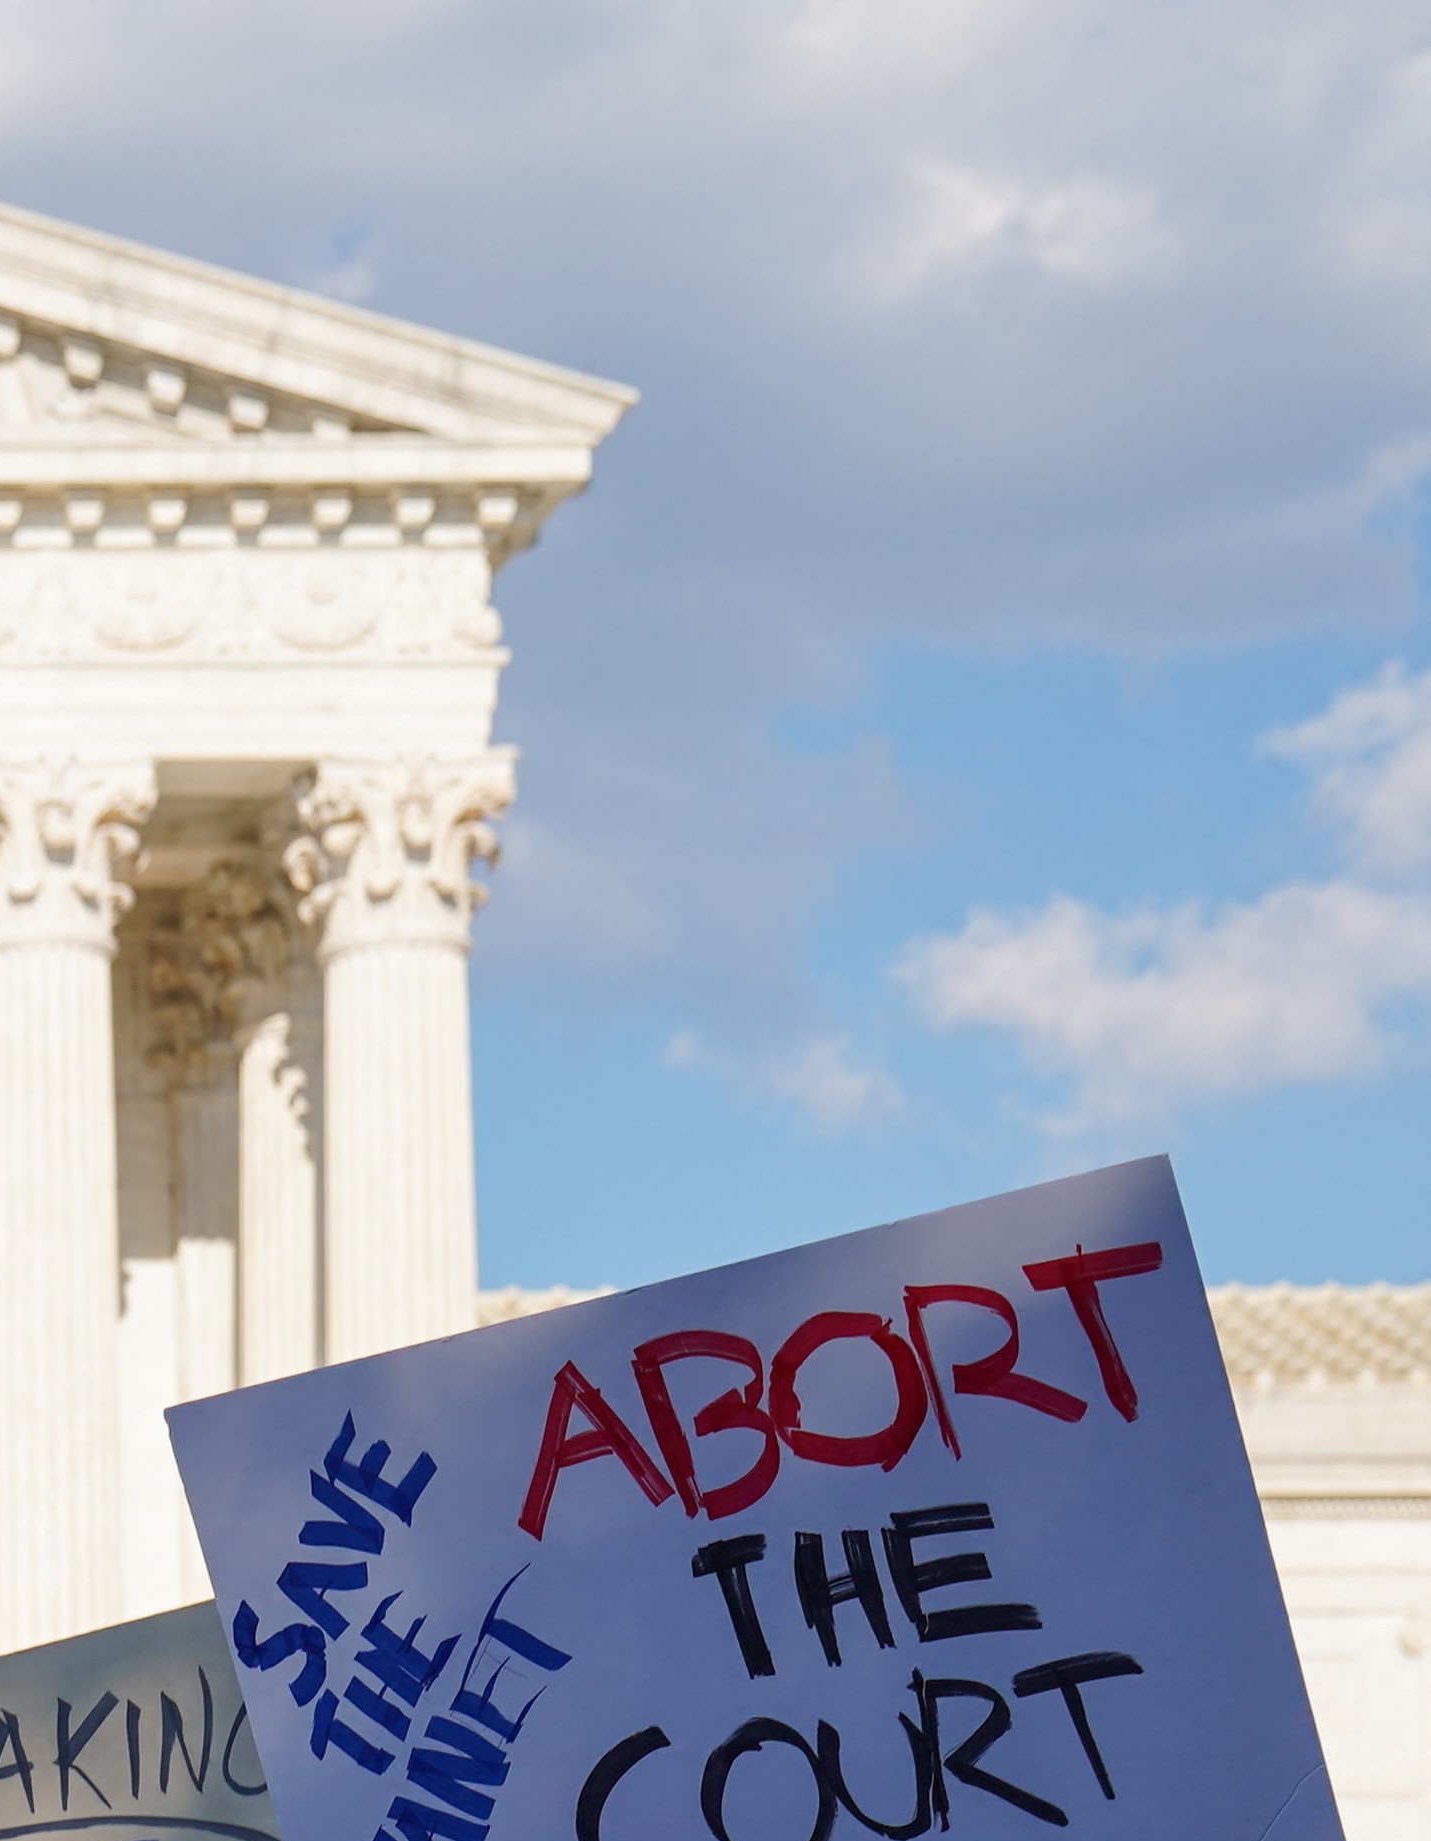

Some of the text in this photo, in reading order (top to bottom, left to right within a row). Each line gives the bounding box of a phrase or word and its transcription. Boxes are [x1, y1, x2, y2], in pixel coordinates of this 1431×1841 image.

[518, 1242, 1163, 1542] ABORT
[231, 1409, 437, 1708] SAVE
[690, 1502, 1043, 1679] THE
[310, 1589, 463, 1775] THE
